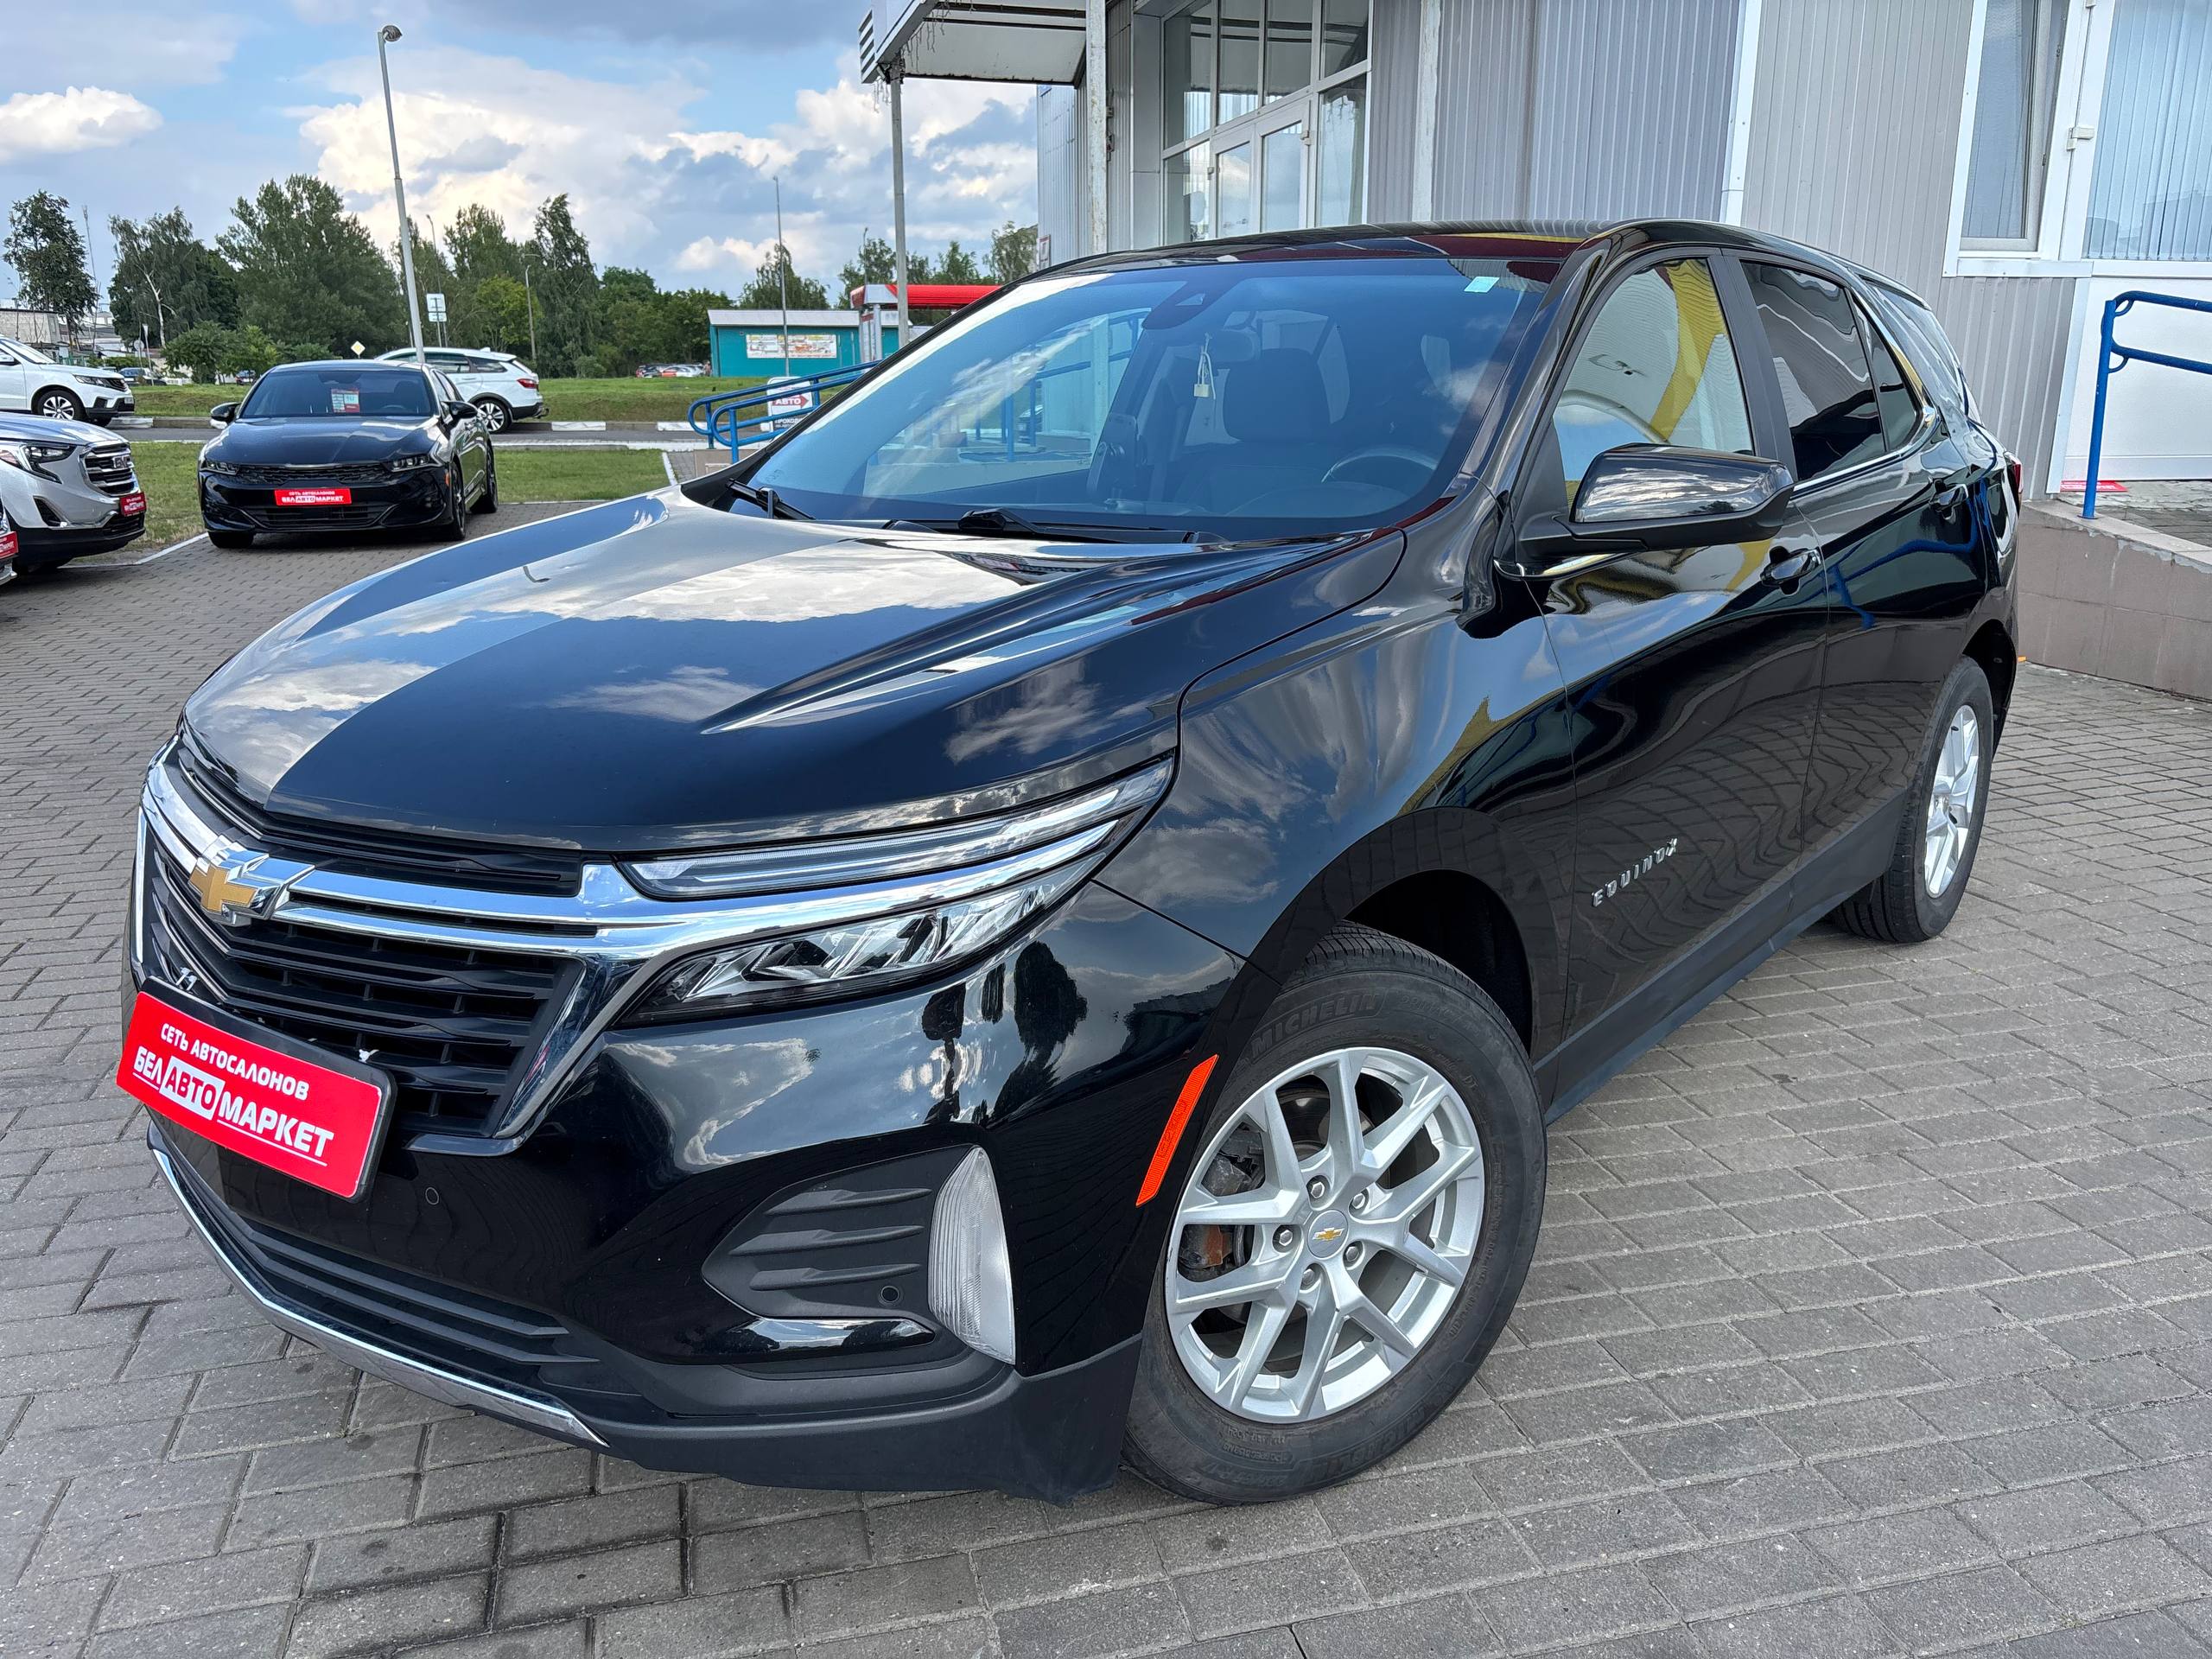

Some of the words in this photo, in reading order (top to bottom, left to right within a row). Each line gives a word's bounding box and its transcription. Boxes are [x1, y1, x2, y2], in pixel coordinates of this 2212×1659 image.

[1591, 837, 1678, 907] EQUINOX
[1250, 993, 1381, 1055] MICHELIN
[160, 1022, 189, 1052] СЕТЬ
[191, 1039, 310, 1101] АВТОСАЛОНОВ
[134, 1046, 334, 1158] БЕЛАВТОМАРКЕТ
